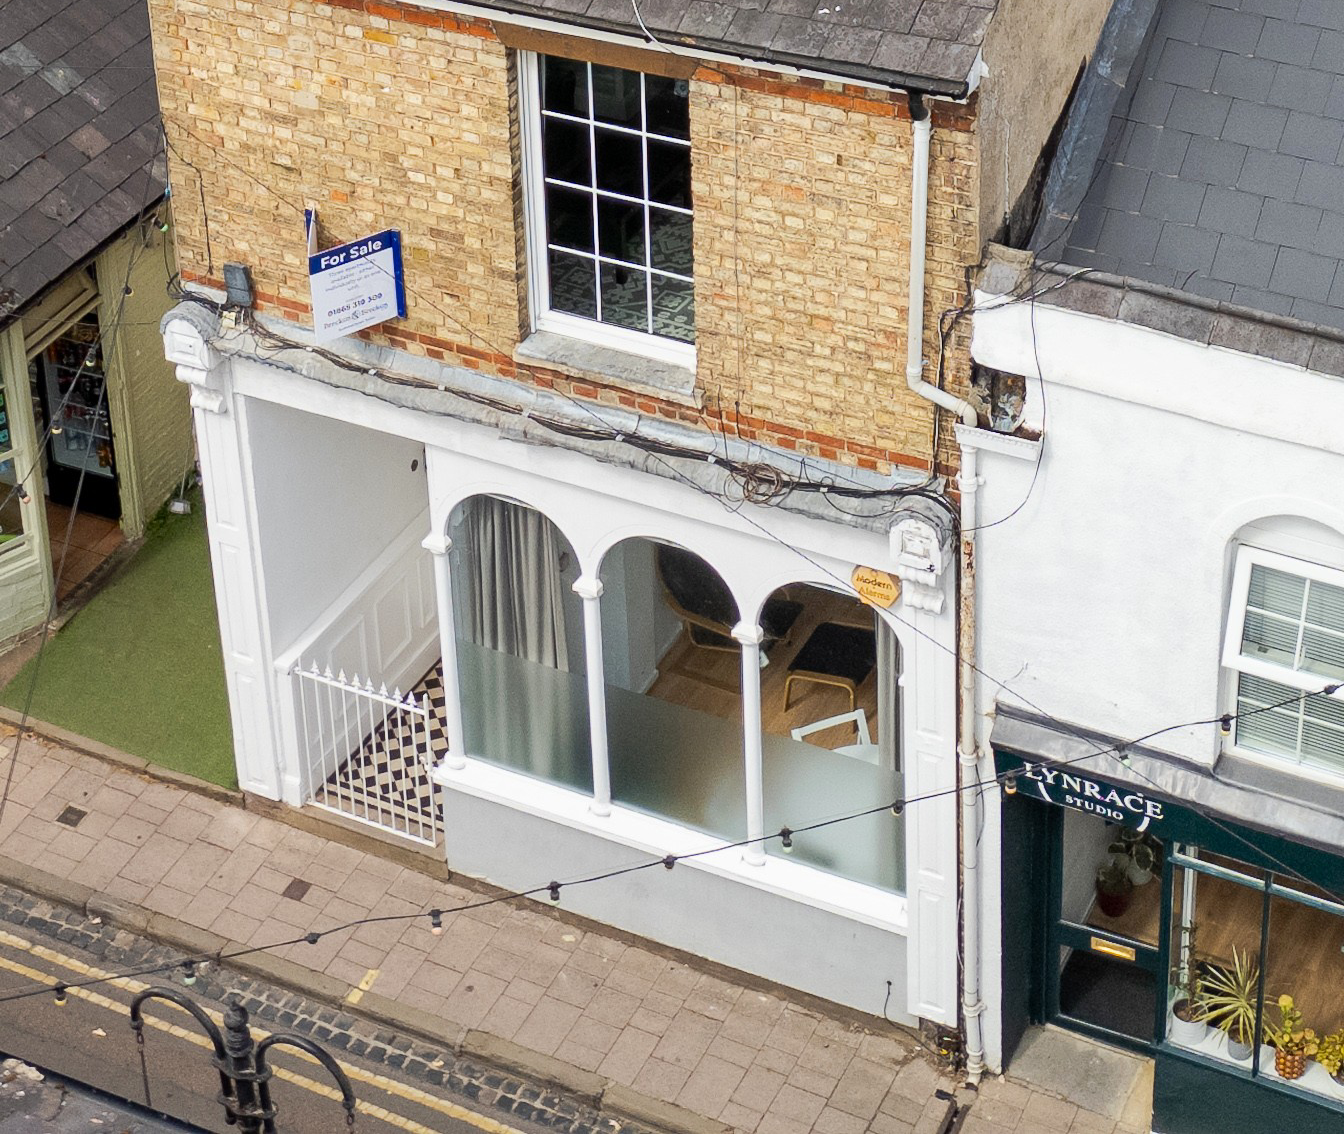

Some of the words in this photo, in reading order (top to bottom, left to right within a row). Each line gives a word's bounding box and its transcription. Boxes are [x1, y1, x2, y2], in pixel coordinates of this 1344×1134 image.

[320, 252, 347, 269] For
[349, 240, 383, 259] Sale
[856, 574, 893, 590] Modern
[1023, 761, 1164, 820] LYNRACE
[1065, 794, 1124, 820] STUDIO
